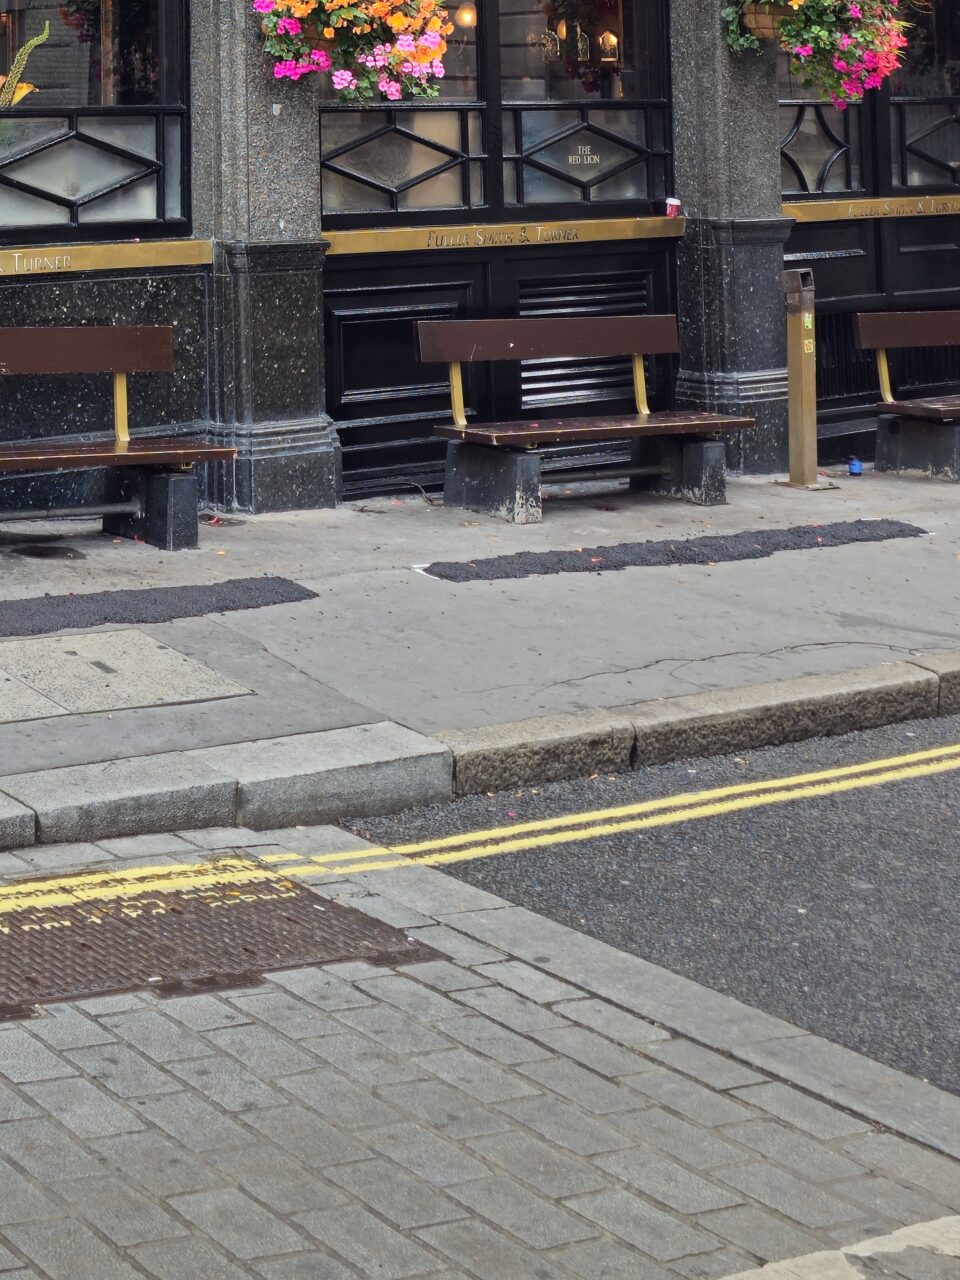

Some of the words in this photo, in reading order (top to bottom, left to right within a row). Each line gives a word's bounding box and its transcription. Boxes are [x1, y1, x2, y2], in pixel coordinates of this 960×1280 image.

[578, 145, 592, 154] THE
[568, 155, 581, 164] RED
[583, 155, 600, 164] LION
[518, 226, 530, 243] &
[11, 252, 72, 273] TURNER
